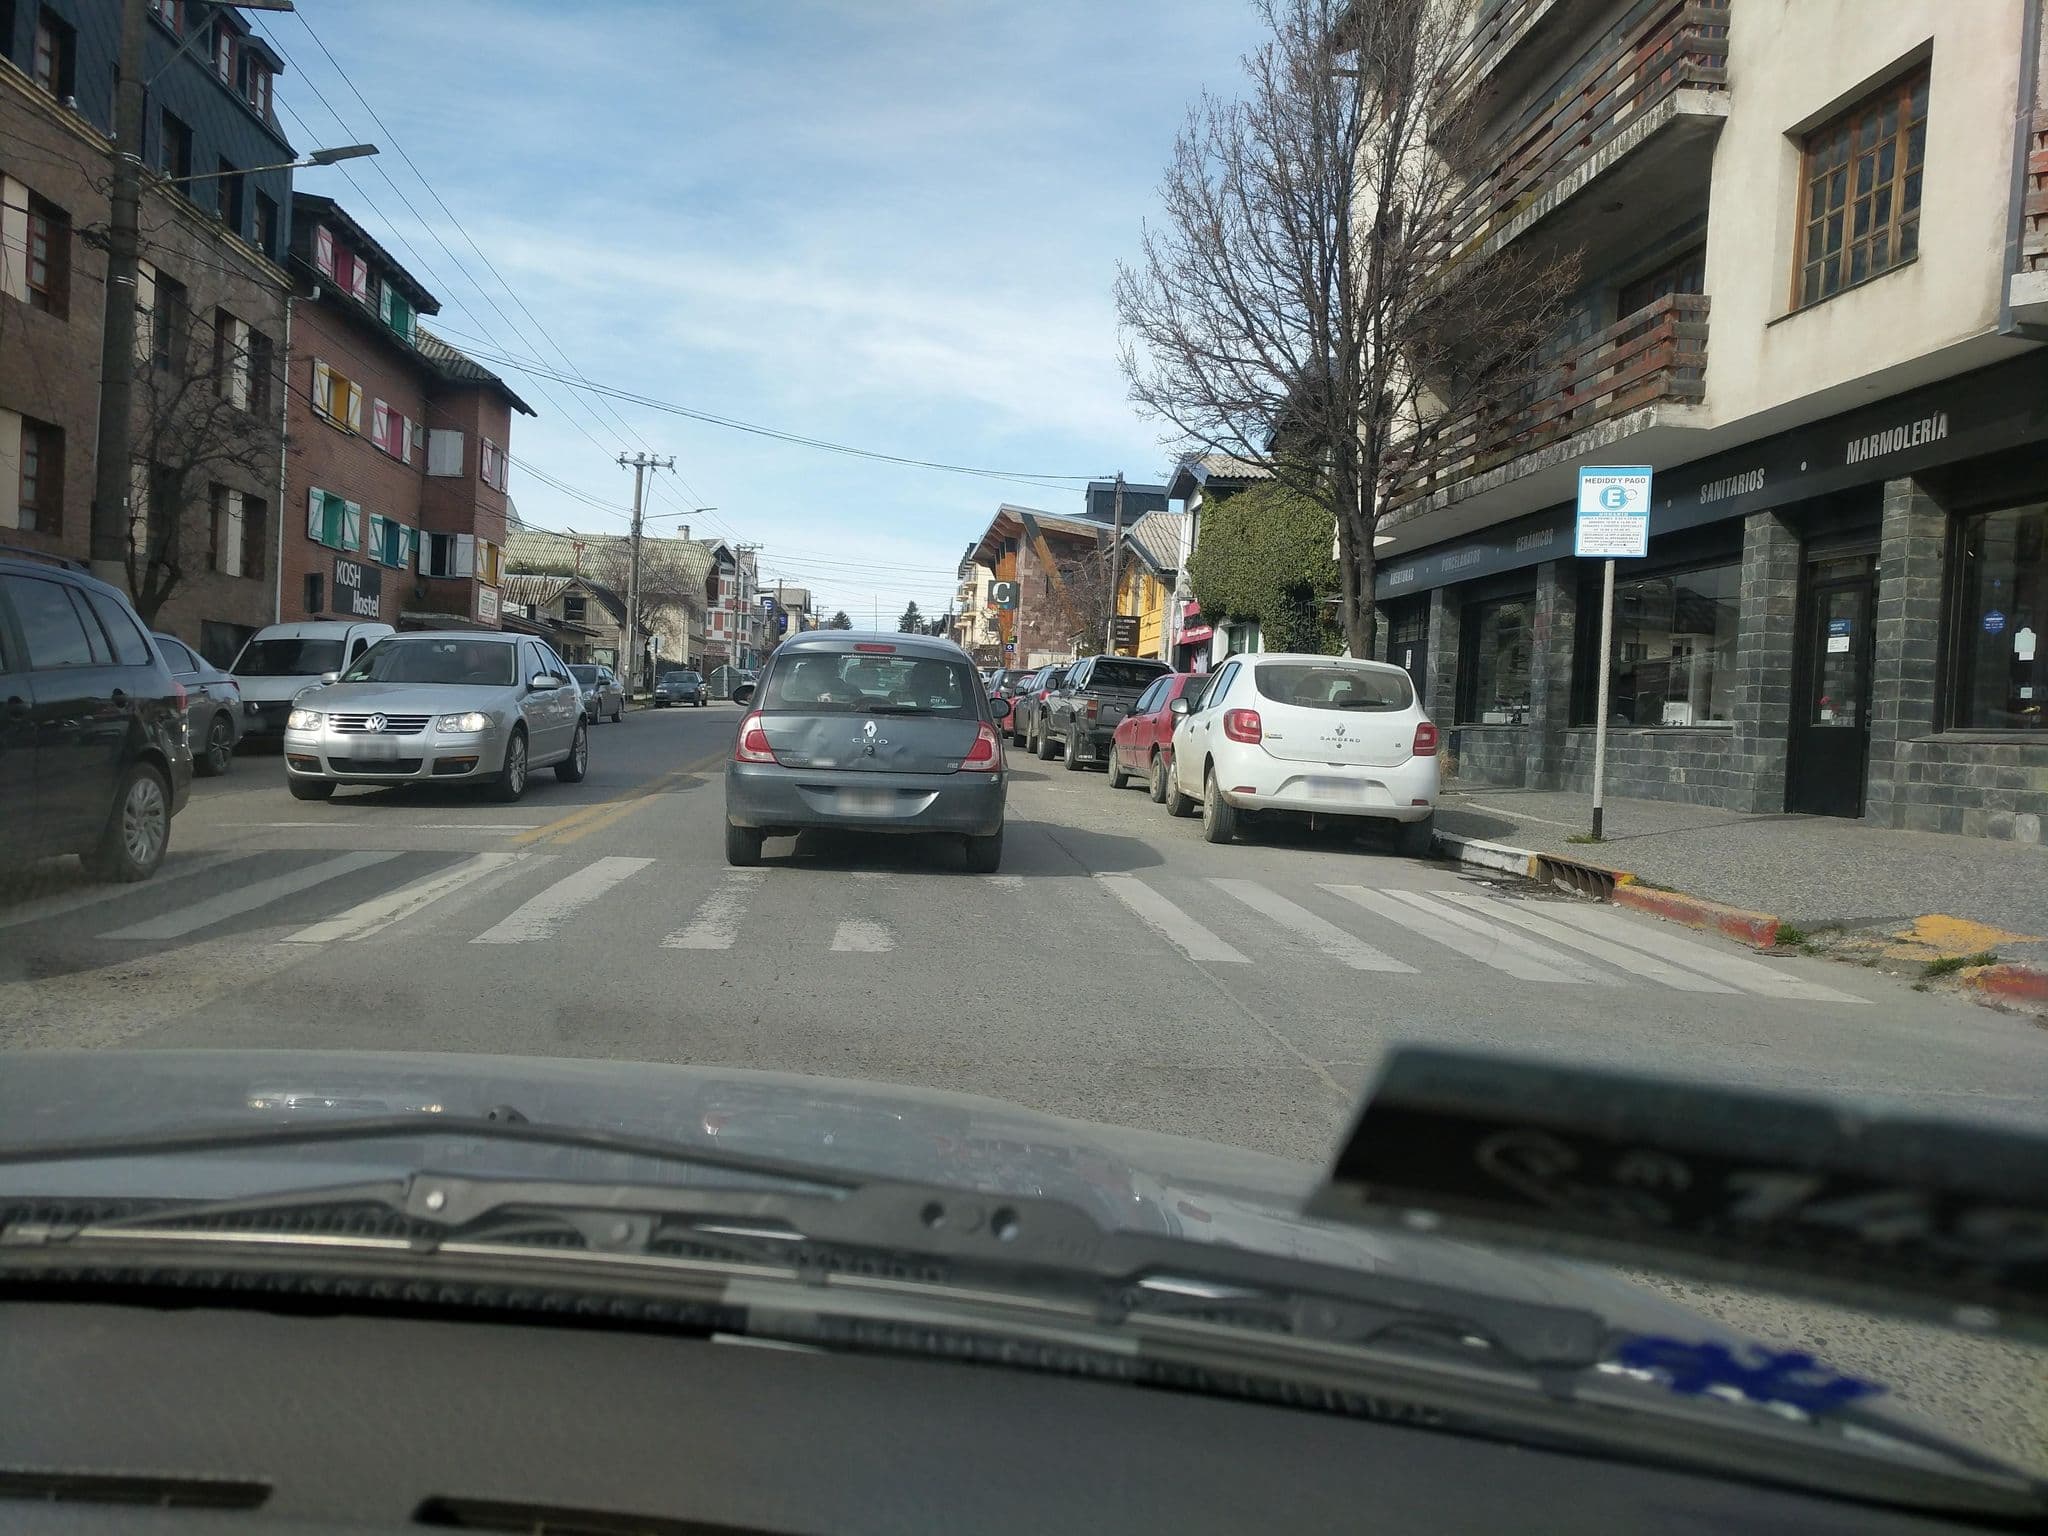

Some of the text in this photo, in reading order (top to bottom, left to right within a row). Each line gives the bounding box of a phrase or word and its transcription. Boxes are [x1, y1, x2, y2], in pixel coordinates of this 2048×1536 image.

[1846, 410, 1948, 465] MARMOLERÍA
[1607, 489, 1622, 507] E
[1700, 467, 1765, 504] SANITARIOS
[1516, 528, 1554, 553] CERÁMICOS
[336, 560, 361, 589] KOSH
[353, 590, 379, 618] Hostel
[992, 582, 1011, 603] C
[852, 737, 888, 745] CLIO
